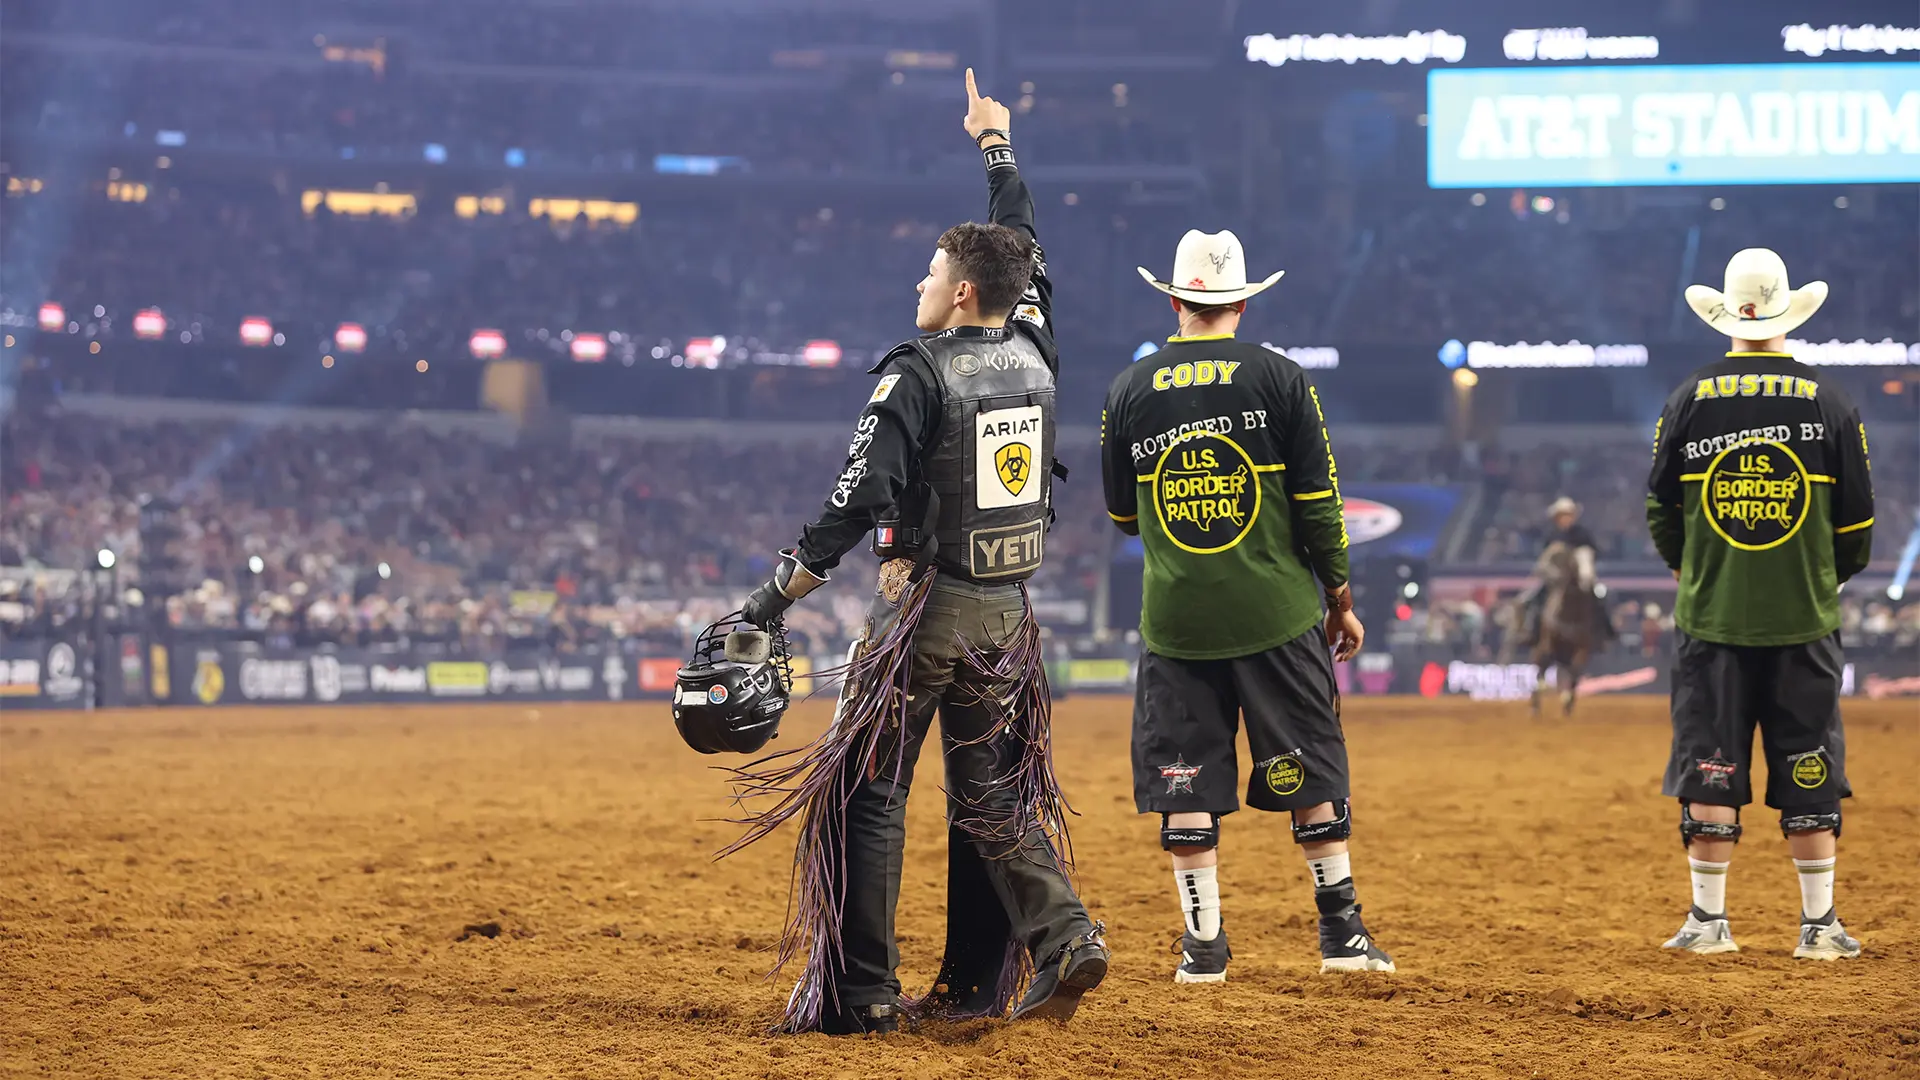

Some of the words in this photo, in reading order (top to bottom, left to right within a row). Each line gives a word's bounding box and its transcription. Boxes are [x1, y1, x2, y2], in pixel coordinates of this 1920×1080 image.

[1457, 93, 1621, 159] AT&T
[1632, 91, 1920, 158] STADIUM
[1153, 360, 1241, 391] CODY
[1694, 374, 1819, 401] AUSTIN
[982, 418, 1039, 438] ARIAT
[1131, 416, 1232, 463] ROTECTED
[1242, 410, 1267, 430] BY
[1681, 425, 1791, 460] ROTECTED
[1800, 423, 1824, 441] BY
[1182, 448, 1219, 470] U.S.
[1740, 454, 1774, 474] U.S.
[1165, 476, 1245, 499] BORDER
[1716, 480, 1797, 499] BORDER
[1168, 498, 1245, 522] PATROL
[1717, 500, 1793, 520] PATROL
[977, 531, 1040, 568] YETI
